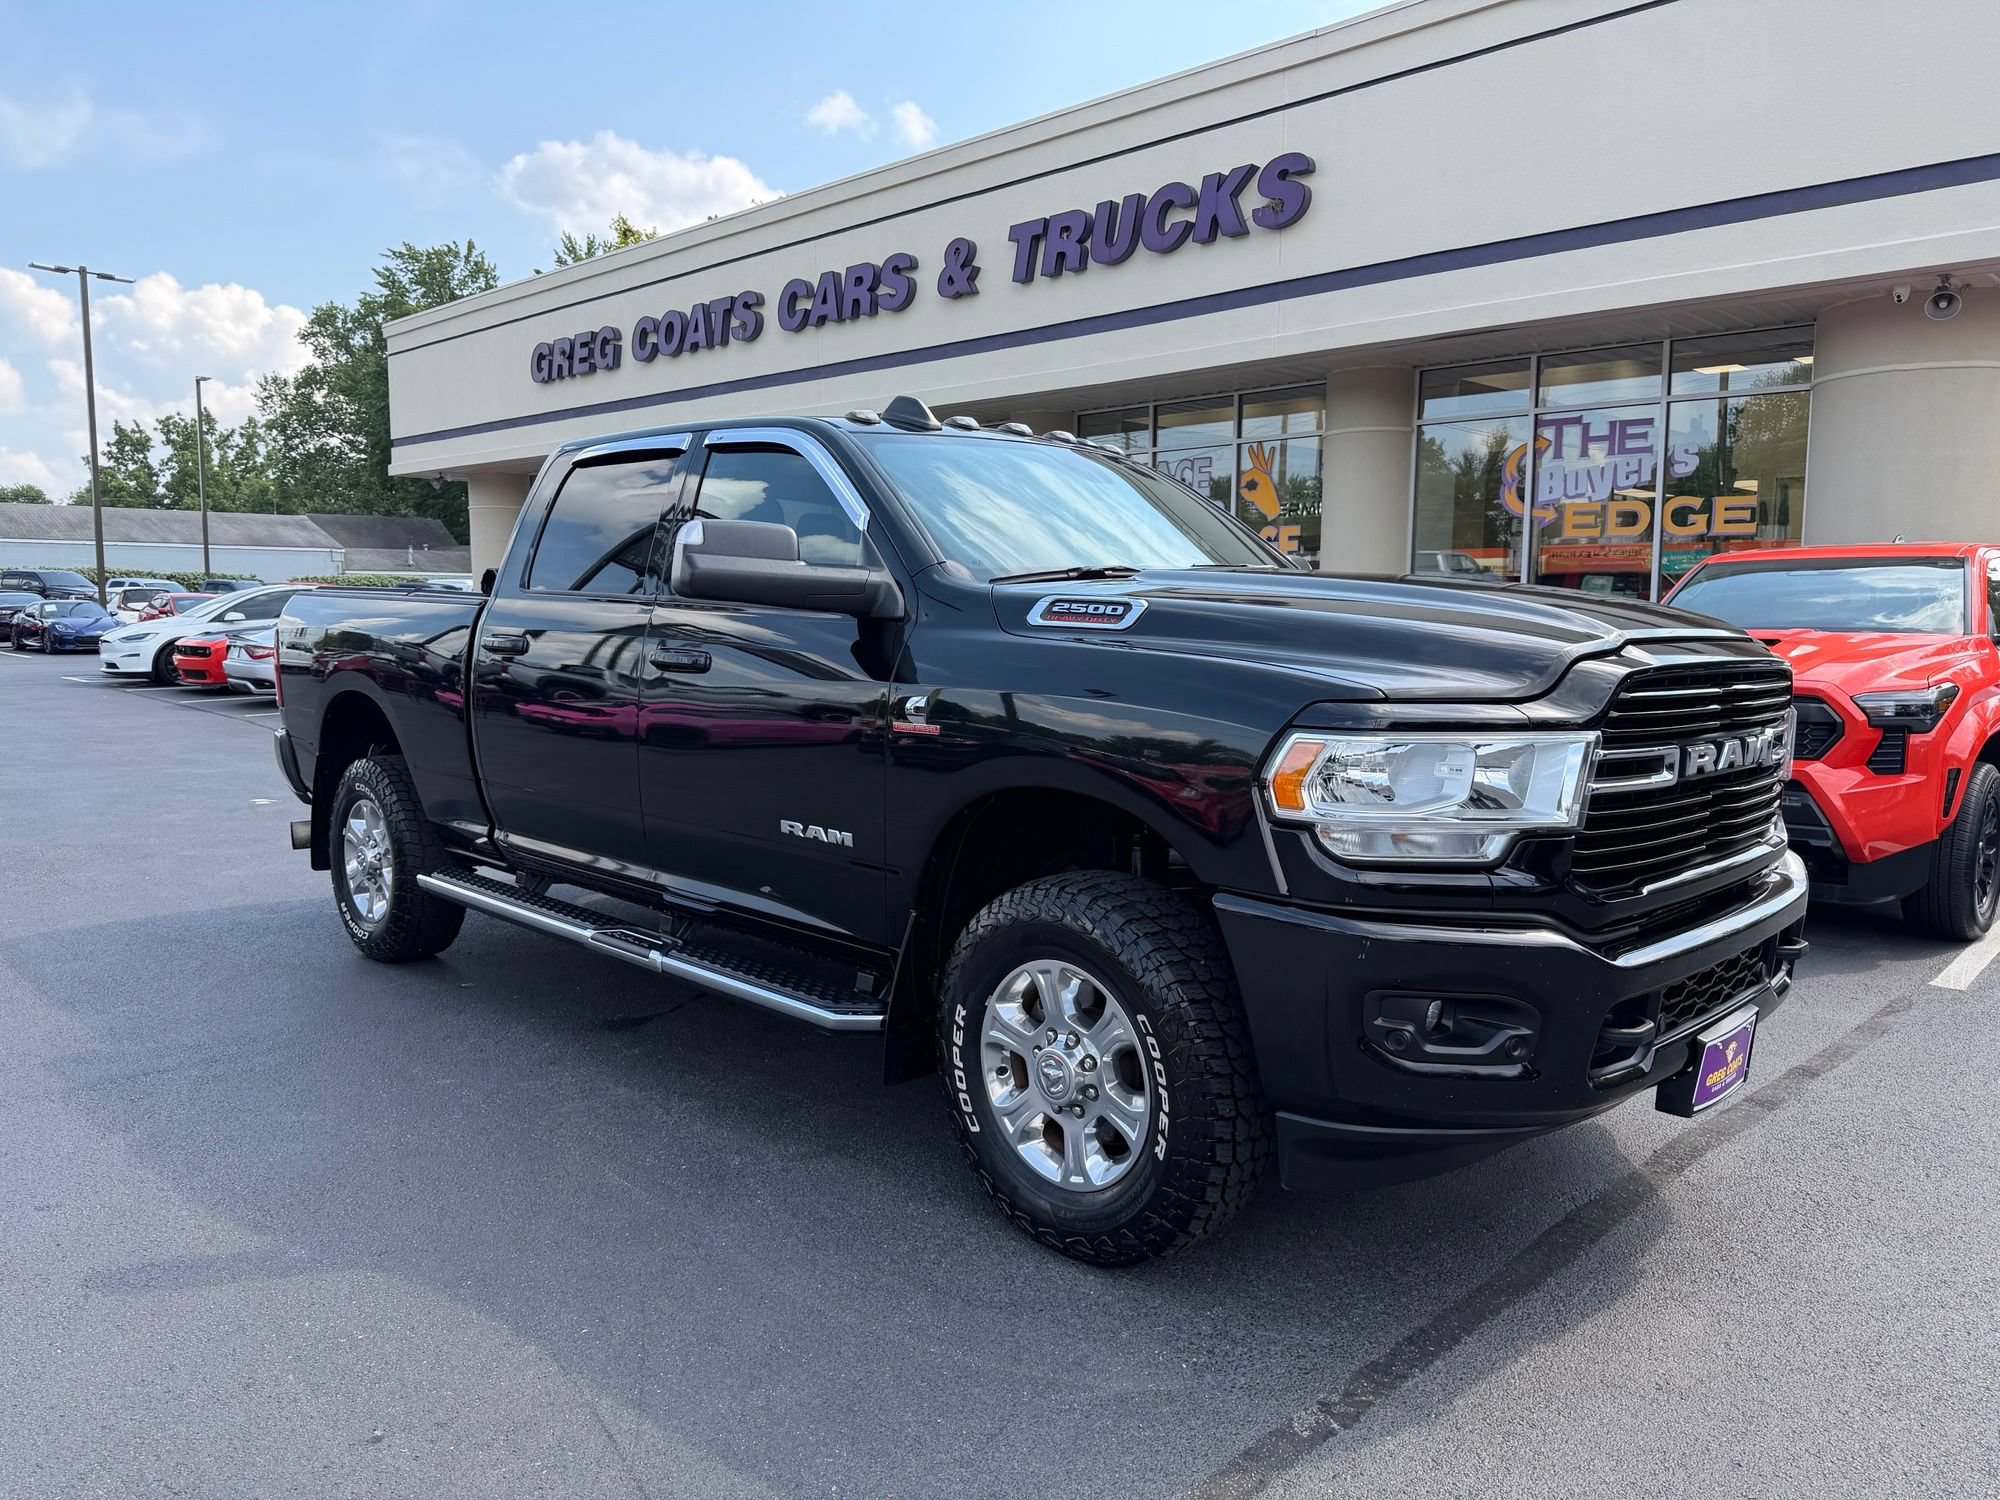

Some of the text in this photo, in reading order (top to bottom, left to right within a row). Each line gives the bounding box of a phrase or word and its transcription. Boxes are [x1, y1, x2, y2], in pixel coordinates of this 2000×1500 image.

[530, 152, 1316, 384] GREG COATS CARS & TRUCKS
[1537, 414, 1655, 459] THE
[1562, 494, 1759, 538] EDGE
[1052, 602, 1124, 615] 2500
[1685, 733, 1772, 777] RAM
[780, 819, 854, 848] RAM
[953, 1003, 981, 1132] COOPER
[1136, 1013, 1170, 1161] COOPER
[1705, 1066, 1726, 1086] GREG
